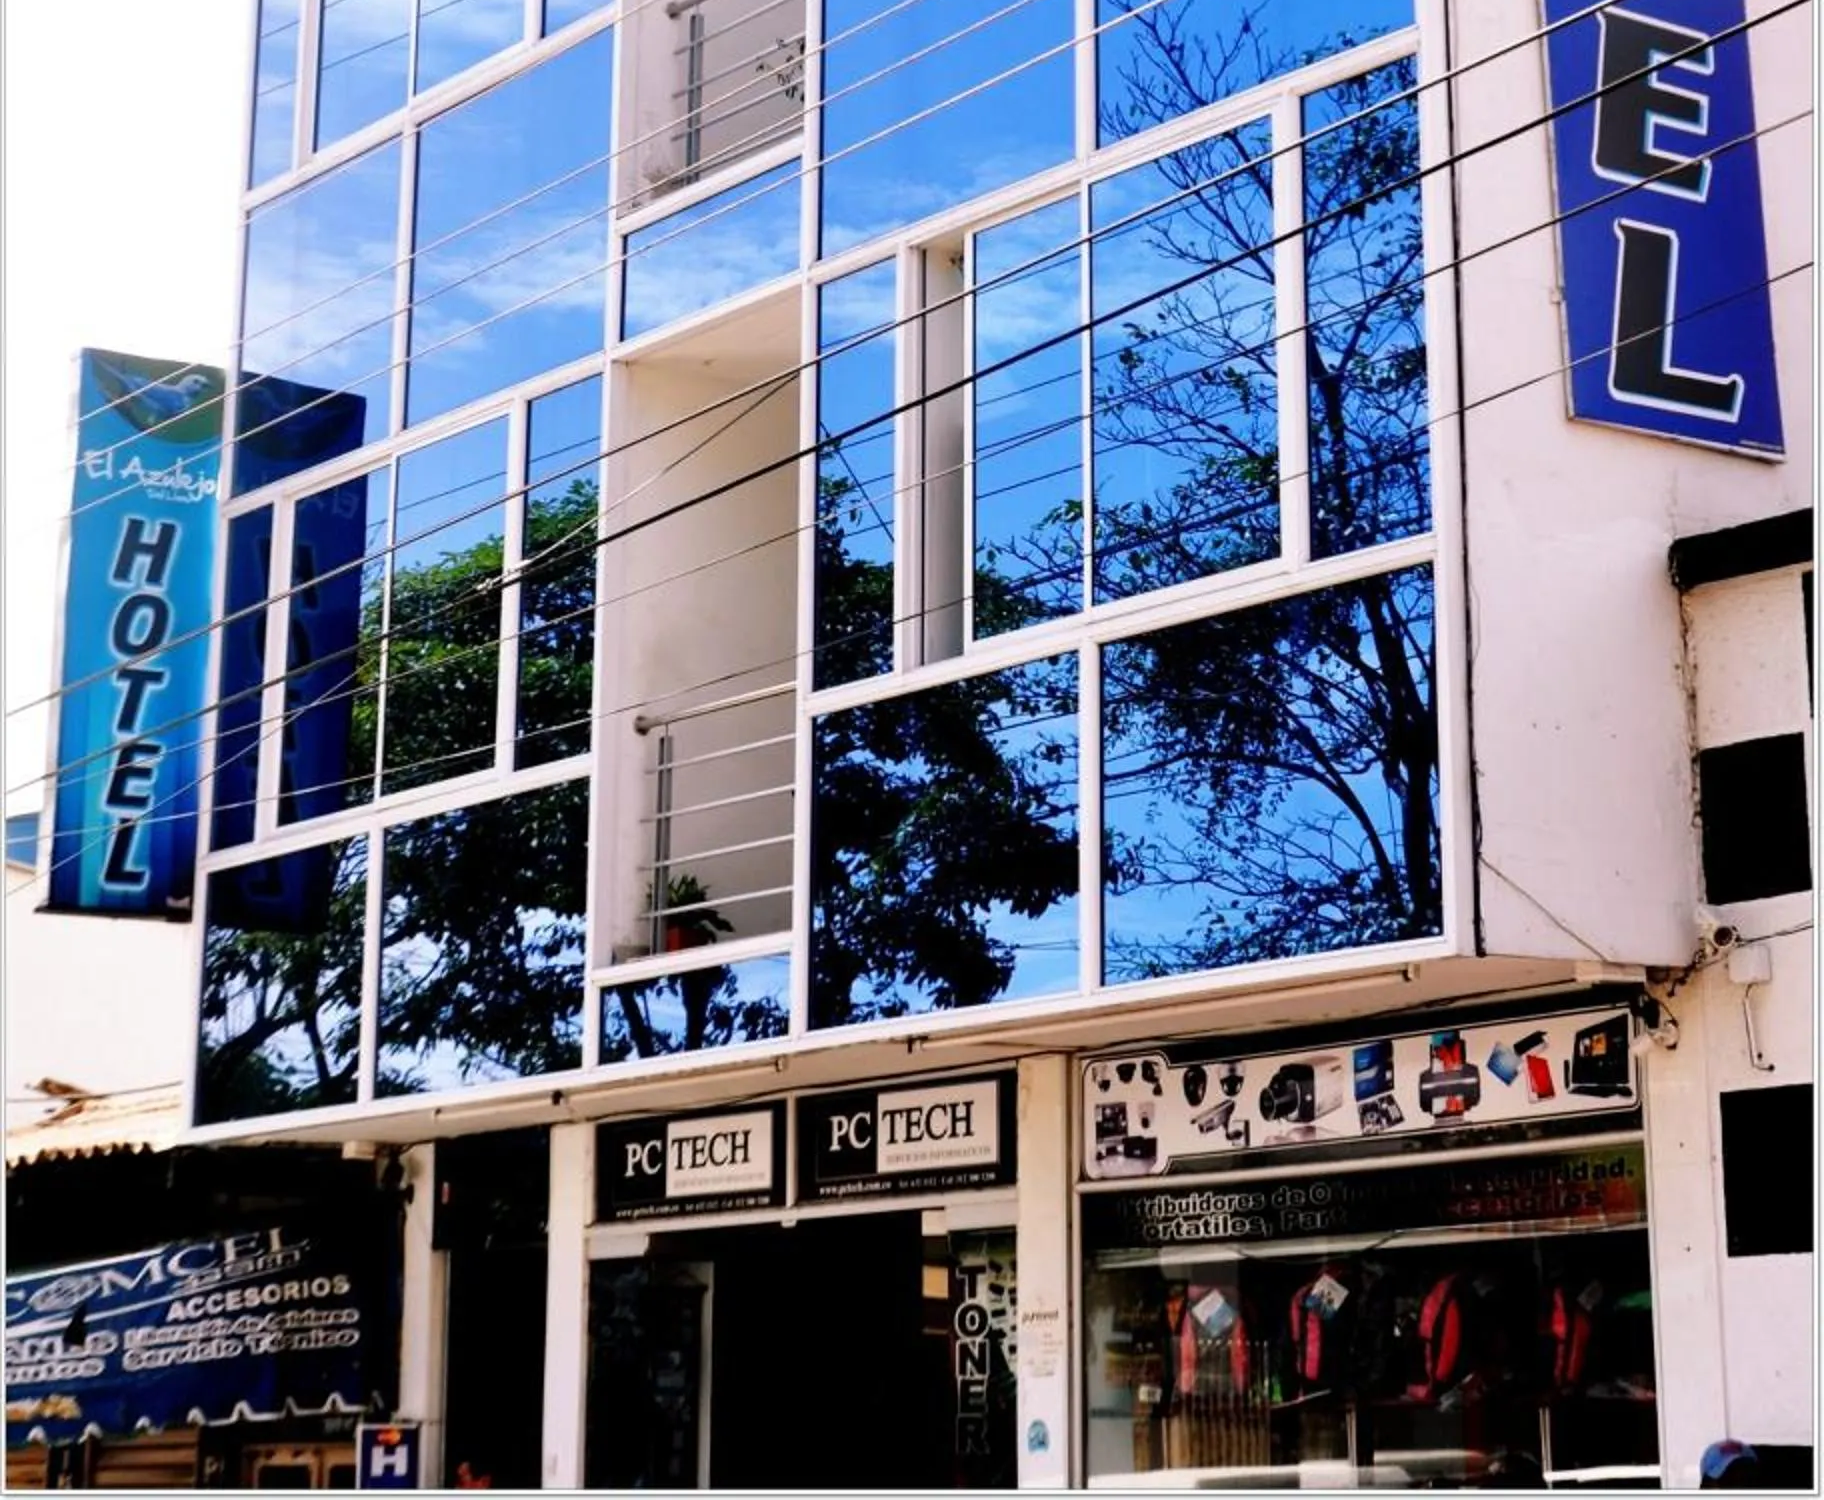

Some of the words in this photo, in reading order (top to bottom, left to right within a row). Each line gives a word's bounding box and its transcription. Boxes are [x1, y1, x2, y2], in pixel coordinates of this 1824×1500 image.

[84, 450, 113, 480] El
[101, 514, 179, 892] HOTEL
[829, 1111, 872, 1152] PC
[881, 1100, 975, 1145] TECH
[624, 1140, 663, 1178] PC
[671, 1129, 752, 1171] TECH
[166, 1274, 351, 1323] ACCESORIOS
[955, 1263, 991, 1455] TONER
[369, 1445, 409, 1477] H
